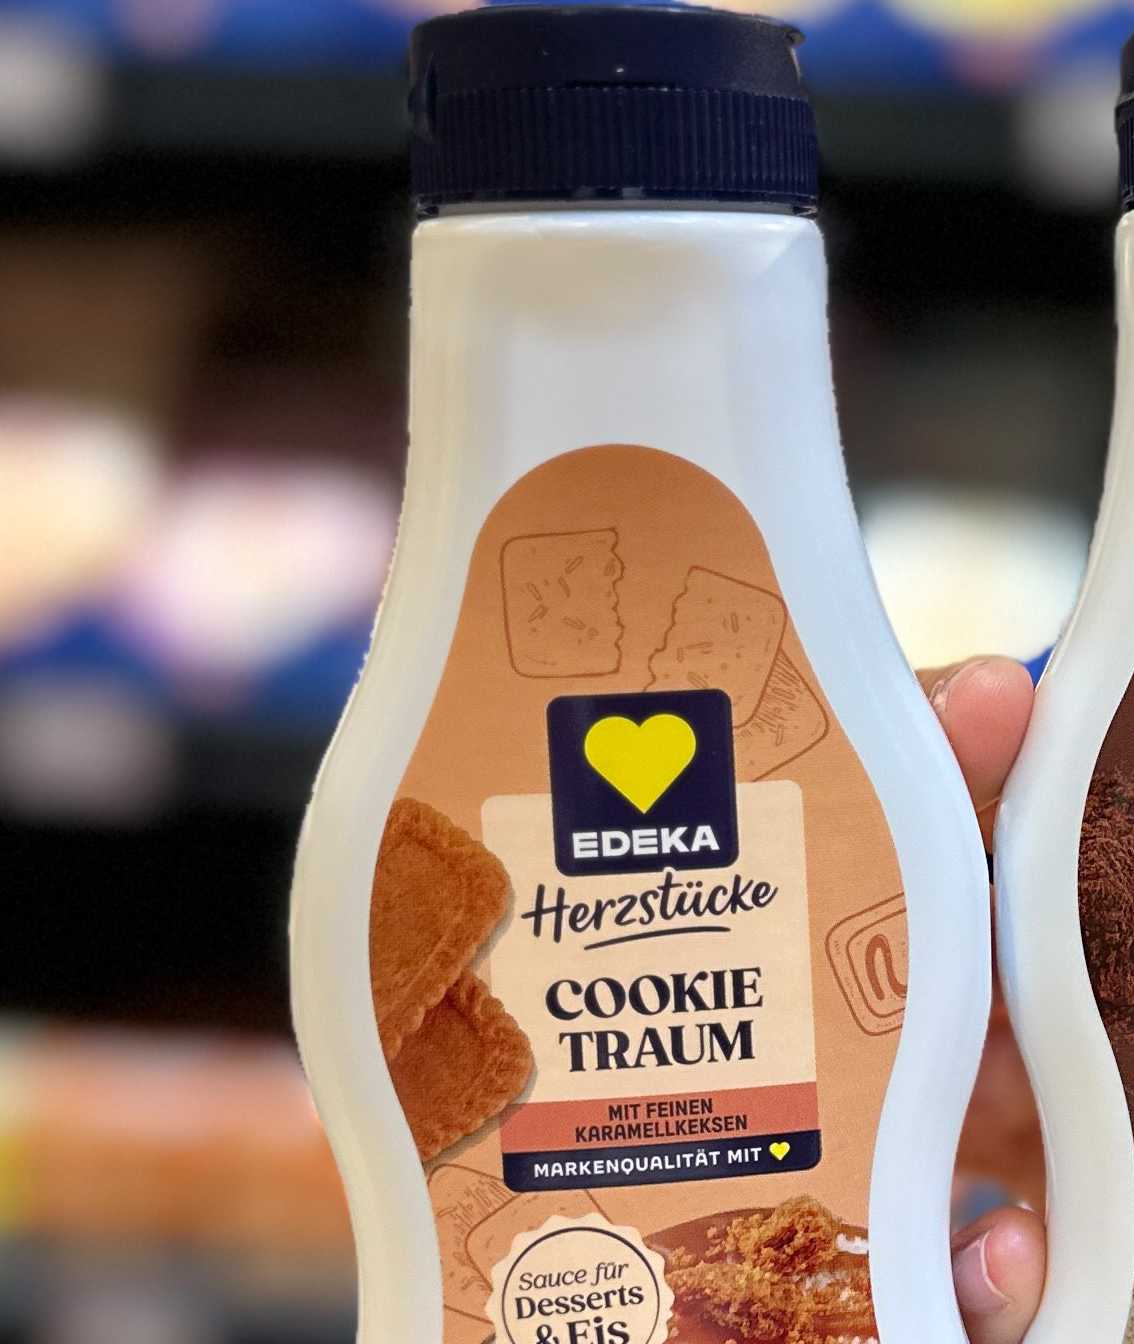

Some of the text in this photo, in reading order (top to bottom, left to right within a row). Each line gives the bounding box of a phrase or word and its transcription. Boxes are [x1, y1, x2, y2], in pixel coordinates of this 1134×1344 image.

[572, 825, 720, 859] EDEKA
[521, 871, 778, 944] Herzstücke
[545, 966, 764, 1021] COOKIE
[559, 1020, 756, 1073] TRAUM
[608, 1098, 714, 1122] MIT FEINEN
[575, 1114, 748, 1143] KARAMELLKEKSEN
[533, 1146, 762, 1178] MARKENQUALITÄT MIT
[518, 1260, 630, 1292] Sauce für
[515, 1285, 645, 1320] Desserts
